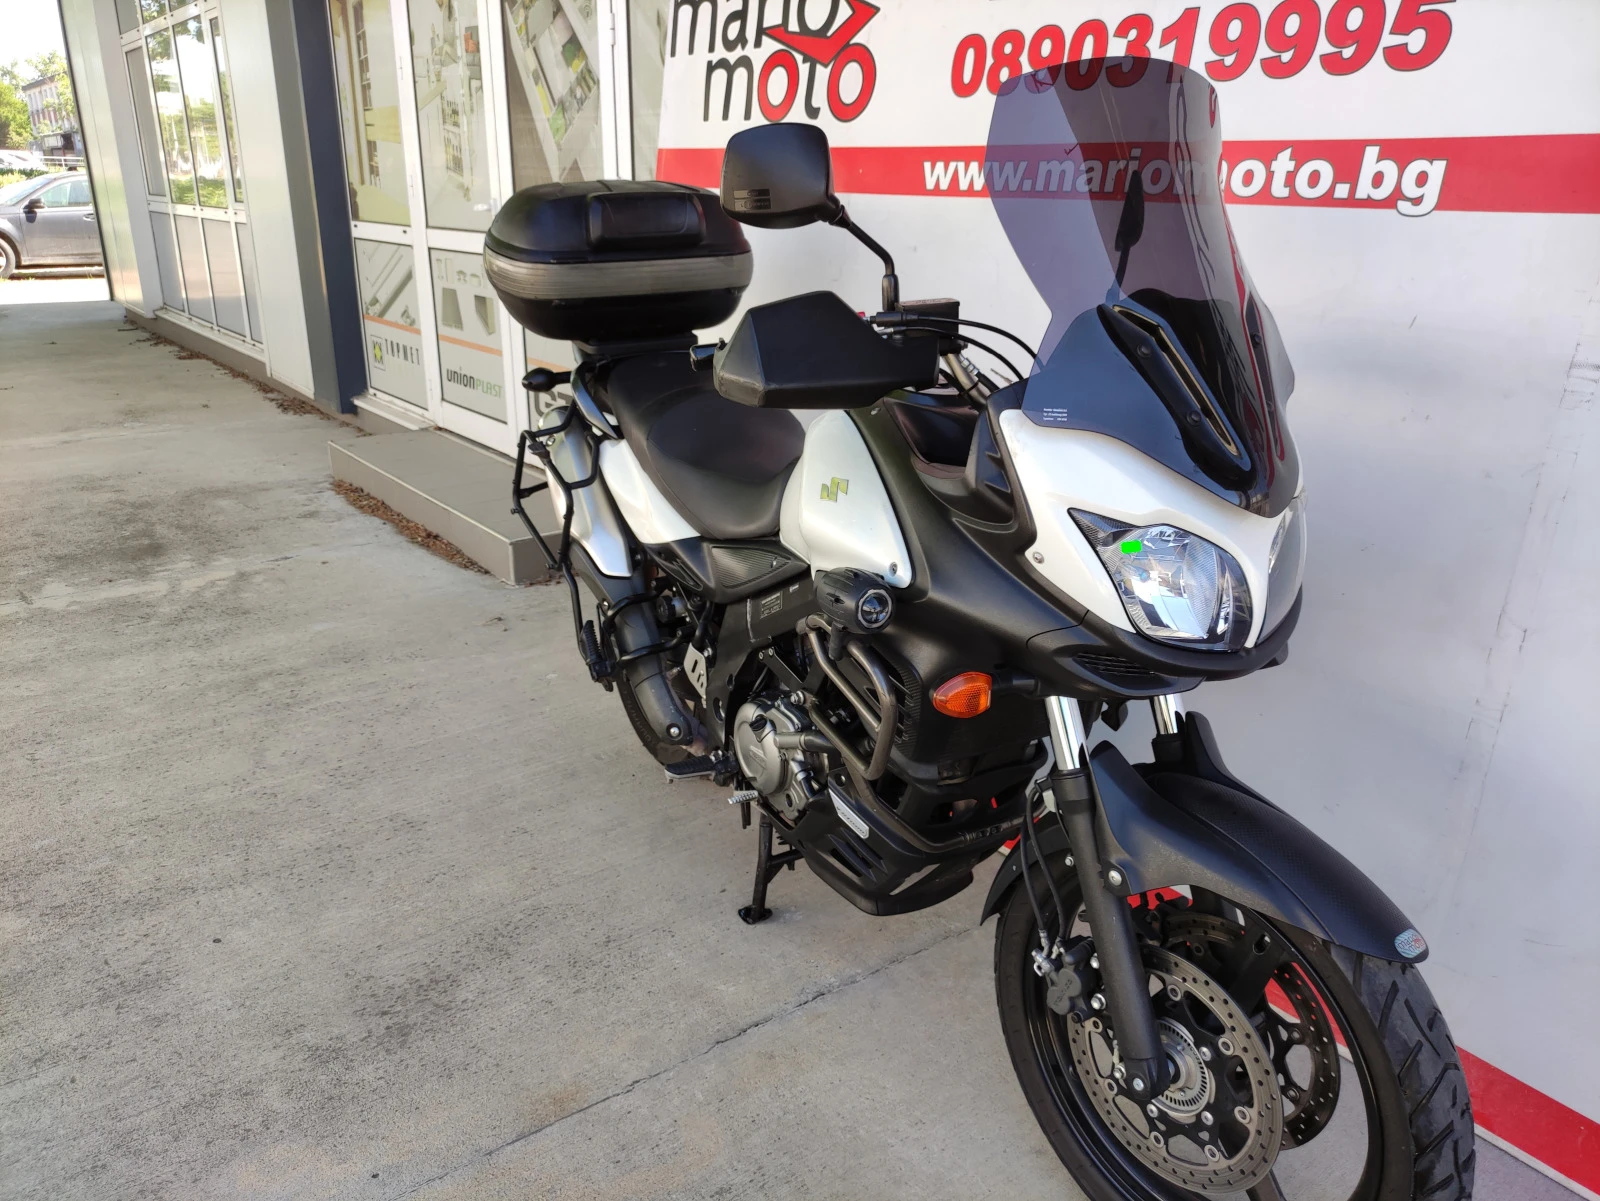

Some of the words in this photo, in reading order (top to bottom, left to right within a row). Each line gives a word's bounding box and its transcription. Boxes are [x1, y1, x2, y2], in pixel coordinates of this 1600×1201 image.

[702, 42, 877, 123] moto
[950, 0, 1456, 98] 0890319995
[922, 145, 1448, 217] www.mariomoto.bg
[384, 338, 421, 366] TOPMET
